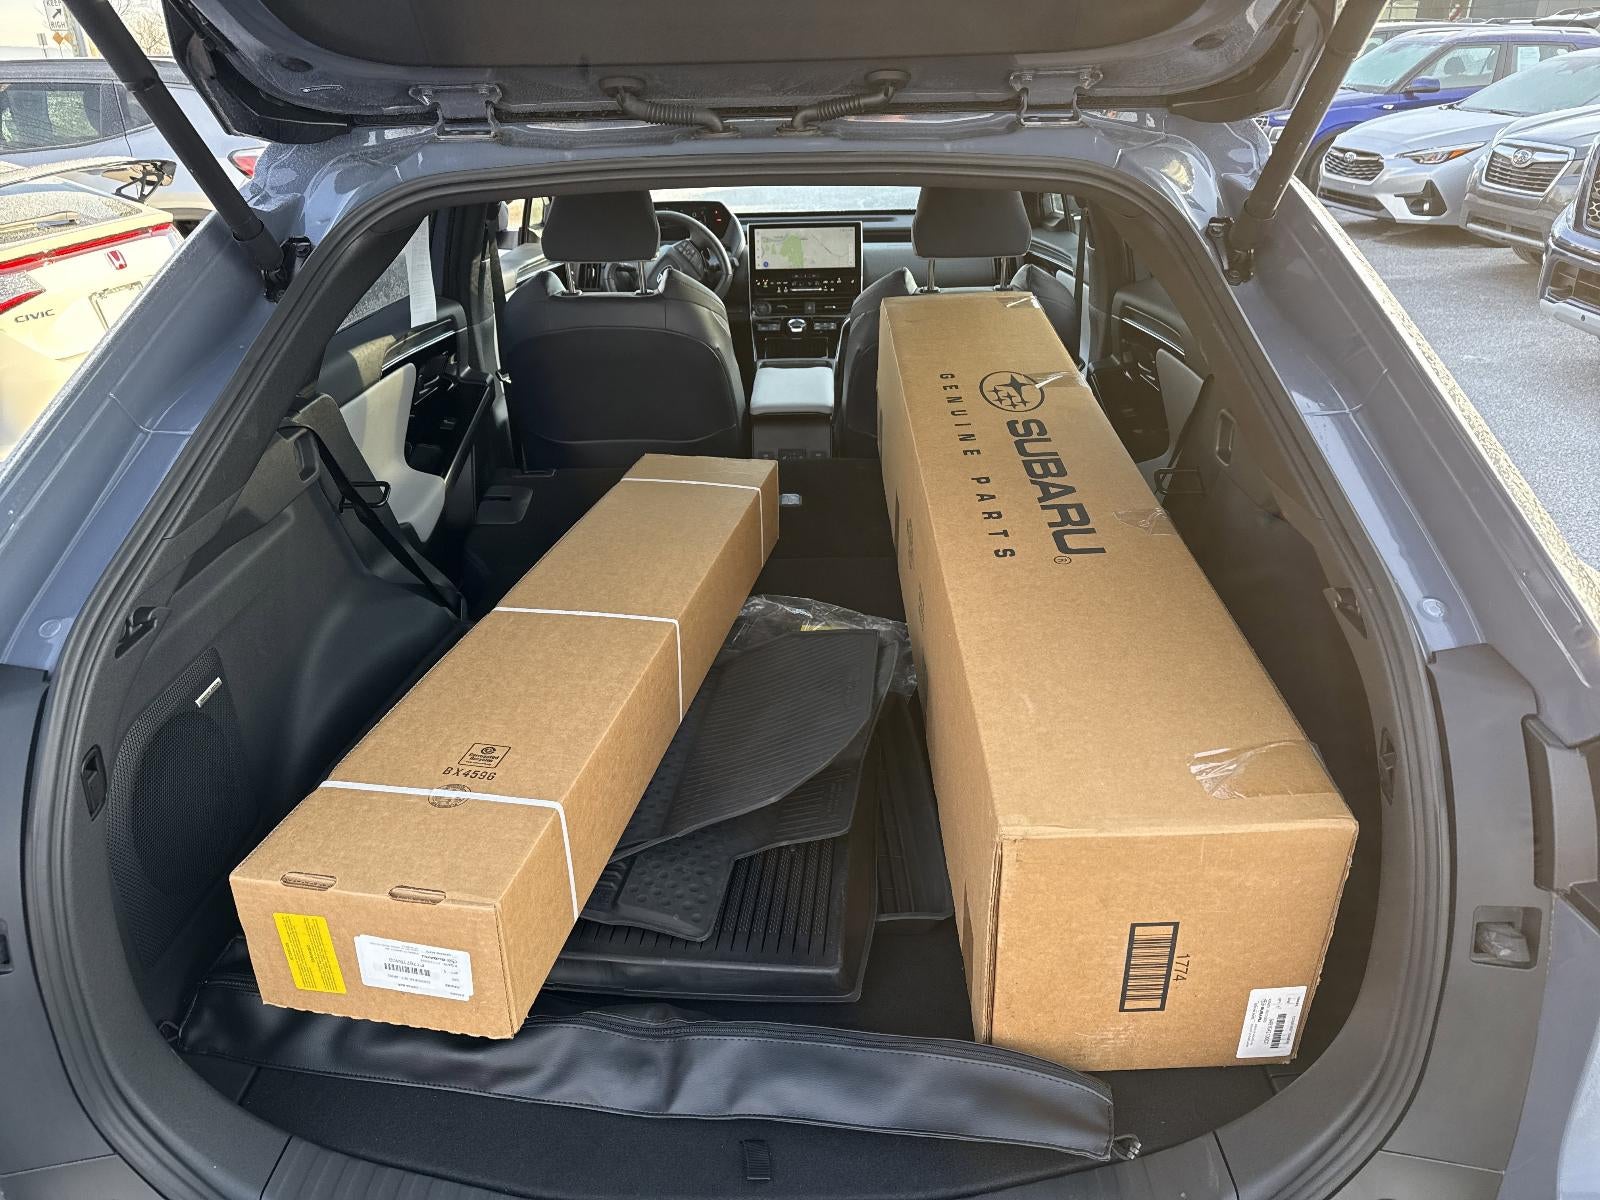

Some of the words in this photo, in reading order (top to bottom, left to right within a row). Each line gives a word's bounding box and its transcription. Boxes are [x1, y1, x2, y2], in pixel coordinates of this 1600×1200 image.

[50, 21, 66, 29] RIGH
[14, 308, 55, 323] CIVIC
[940, 373, 981, 456] GENUINE
[971, 476, 1016, 558] PARTS
[1006, 418, 1107, 555] SUBARU
[1173, 953, 1190, 982] 1774
